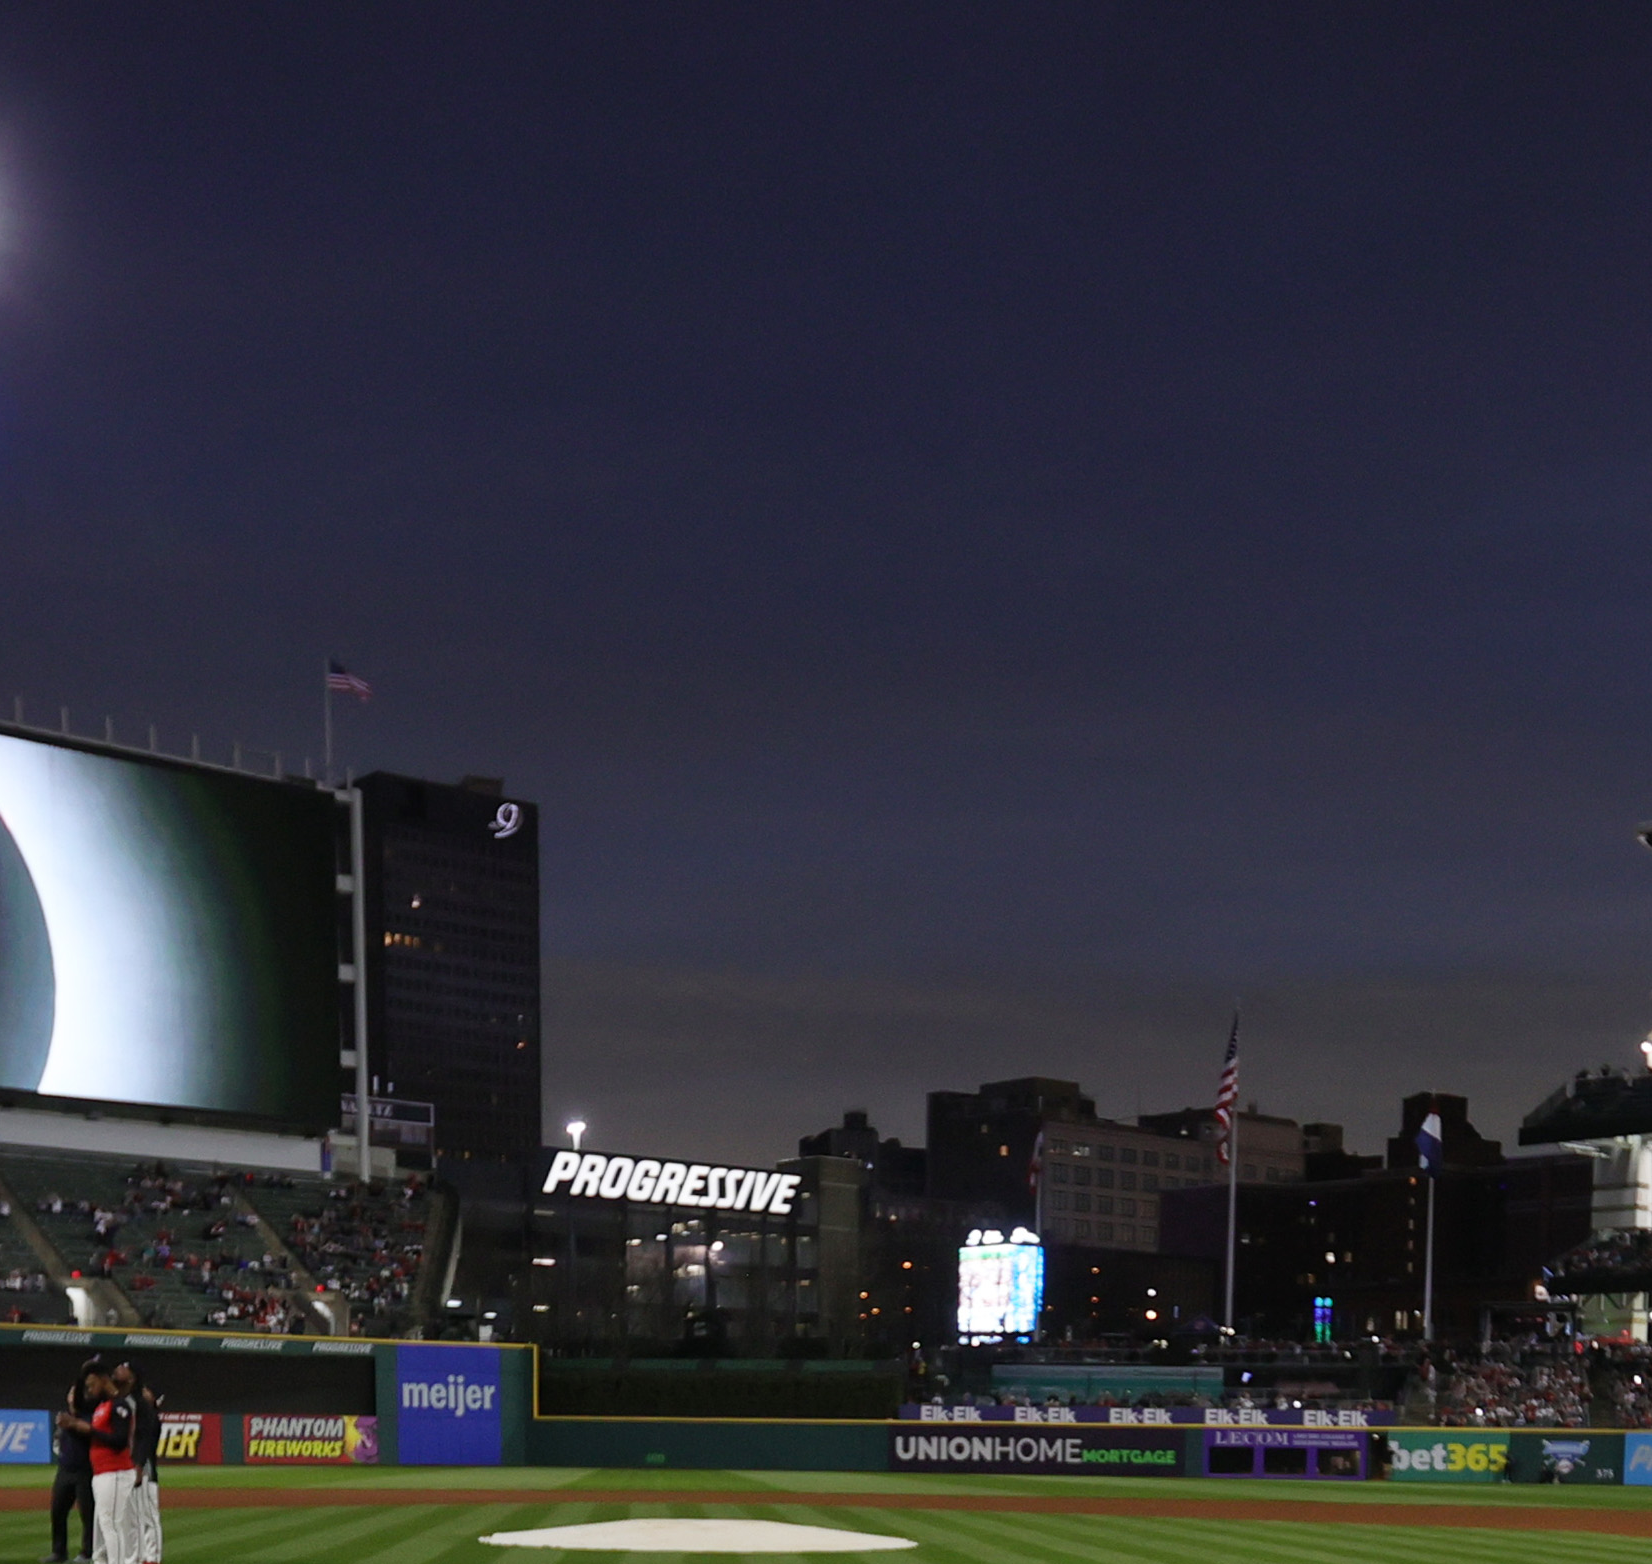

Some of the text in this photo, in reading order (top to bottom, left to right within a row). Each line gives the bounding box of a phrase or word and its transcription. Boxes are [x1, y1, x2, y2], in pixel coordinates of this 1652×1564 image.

[493, 802, 519, 839] 9
[541, 1150, 802, 1215] PROGRESSIVE
[402, 1374, 496, 1417] meijer
[250, 1417, 344, 1438] PHANTOM
[1215, 1431, 1289, 1446] LECOM
[249, 1440, 344, 1458] FIREWORKS
[1082, 1450, 1177, 1465] MORTGAGE
[1389, 1440, 1508, 1472] bet365
